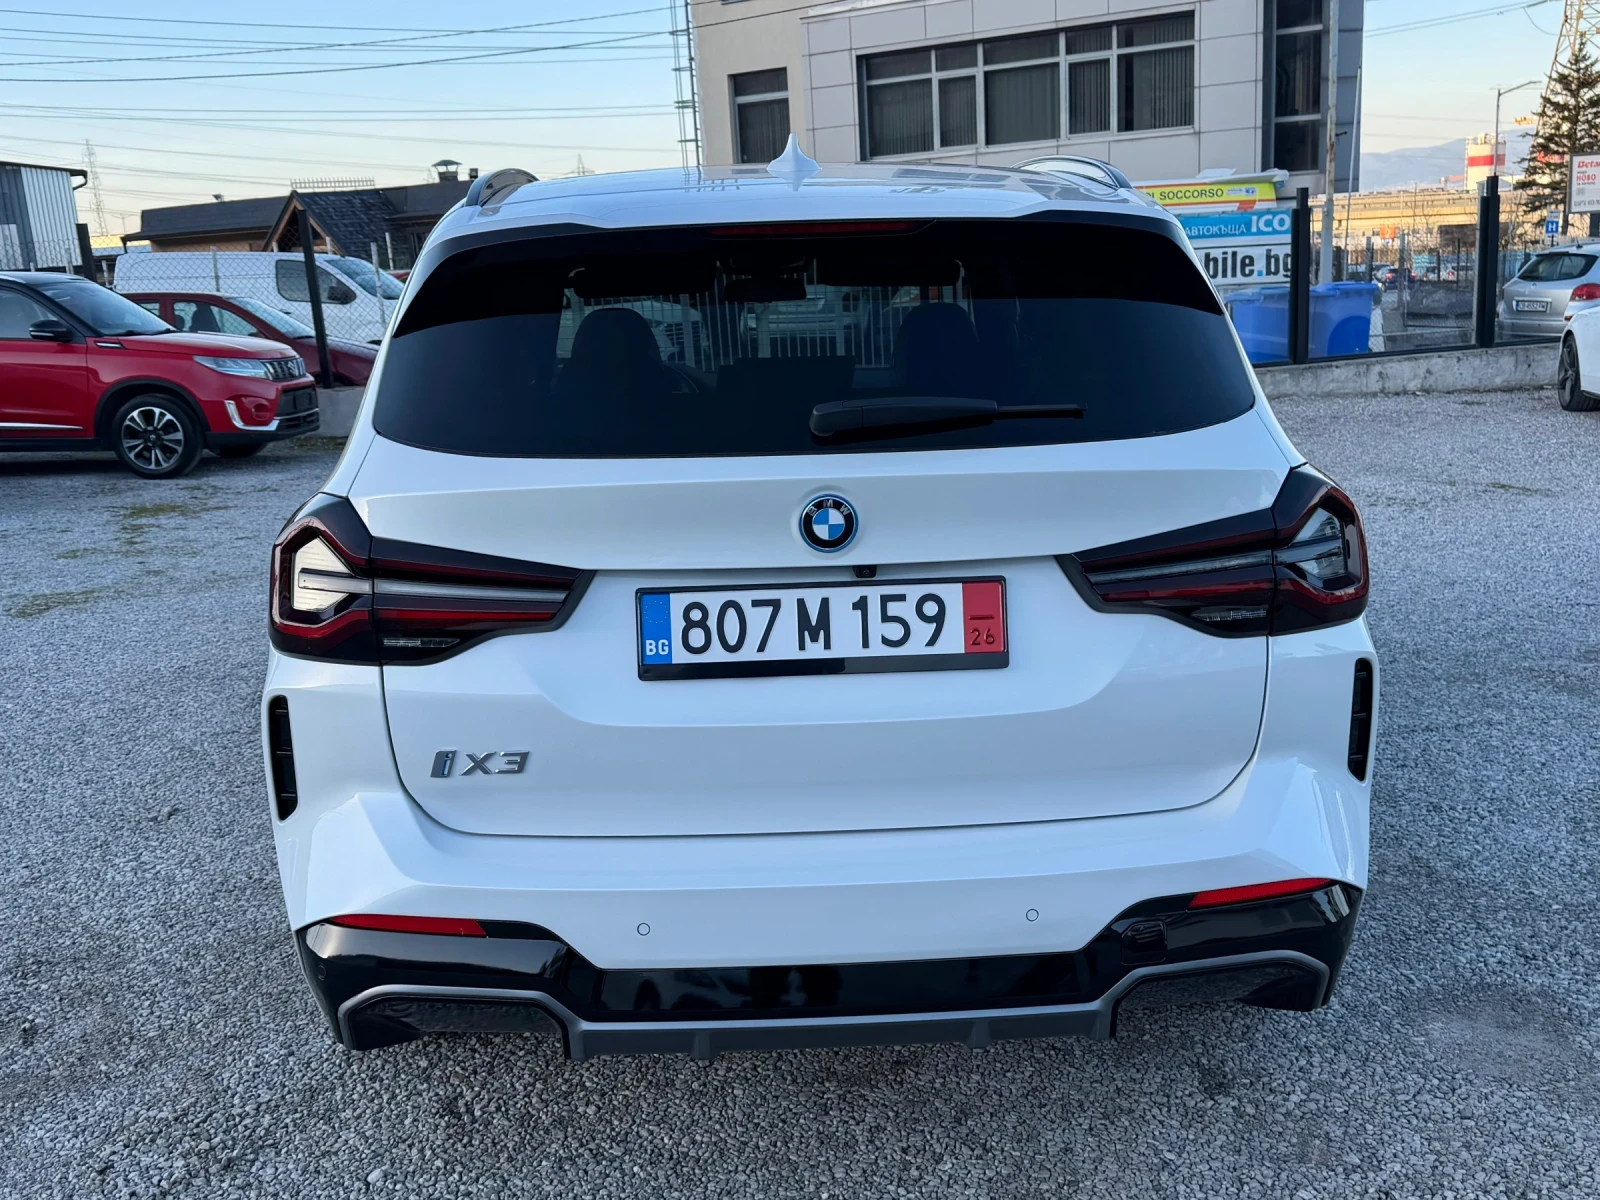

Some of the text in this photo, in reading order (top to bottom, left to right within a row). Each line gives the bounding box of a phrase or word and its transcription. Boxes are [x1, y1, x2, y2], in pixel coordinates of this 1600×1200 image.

[1159, 188, 1224, 200] SOCCORSO
[1184, 213, 1291, 236] АВТОКЪЩА ICO
[806, 499, 851, 517] BMW
[681, 592, 947, 655] 807 M 159
[645, 638, 669, 656] BG
[970, 628, 996, 647] 26
[430, 749, 530, 778] iX3
